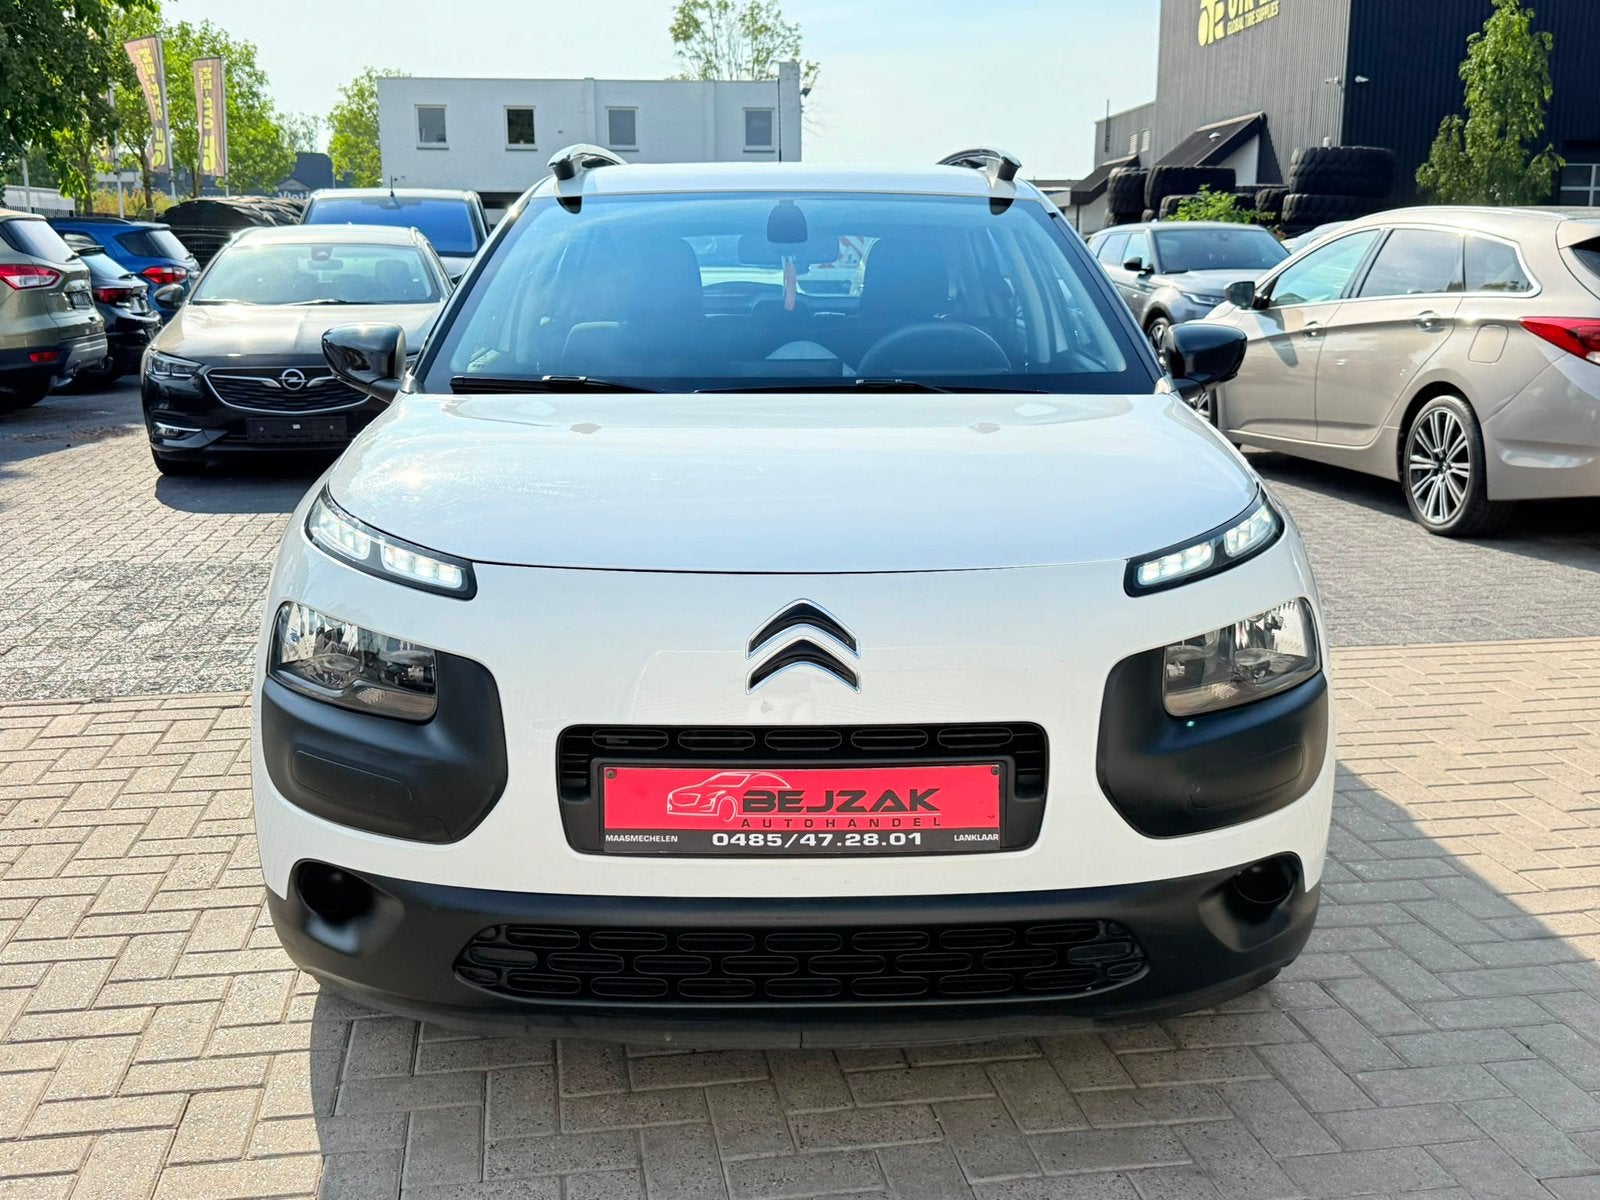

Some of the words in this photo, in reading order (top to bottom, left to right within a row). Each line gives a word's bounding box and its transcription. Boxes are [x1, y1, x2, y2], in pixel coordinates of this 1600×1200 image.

[743, 788, 941, 813] BEJZAK
[741, 817, 941, 829] AUTOHANDEL
[605, 834, 678, 843] MAASMECHELEN
[712, 832, 922, 848] 0485/47.28.01
[953, 833, 999, 842] LANKLAAR
